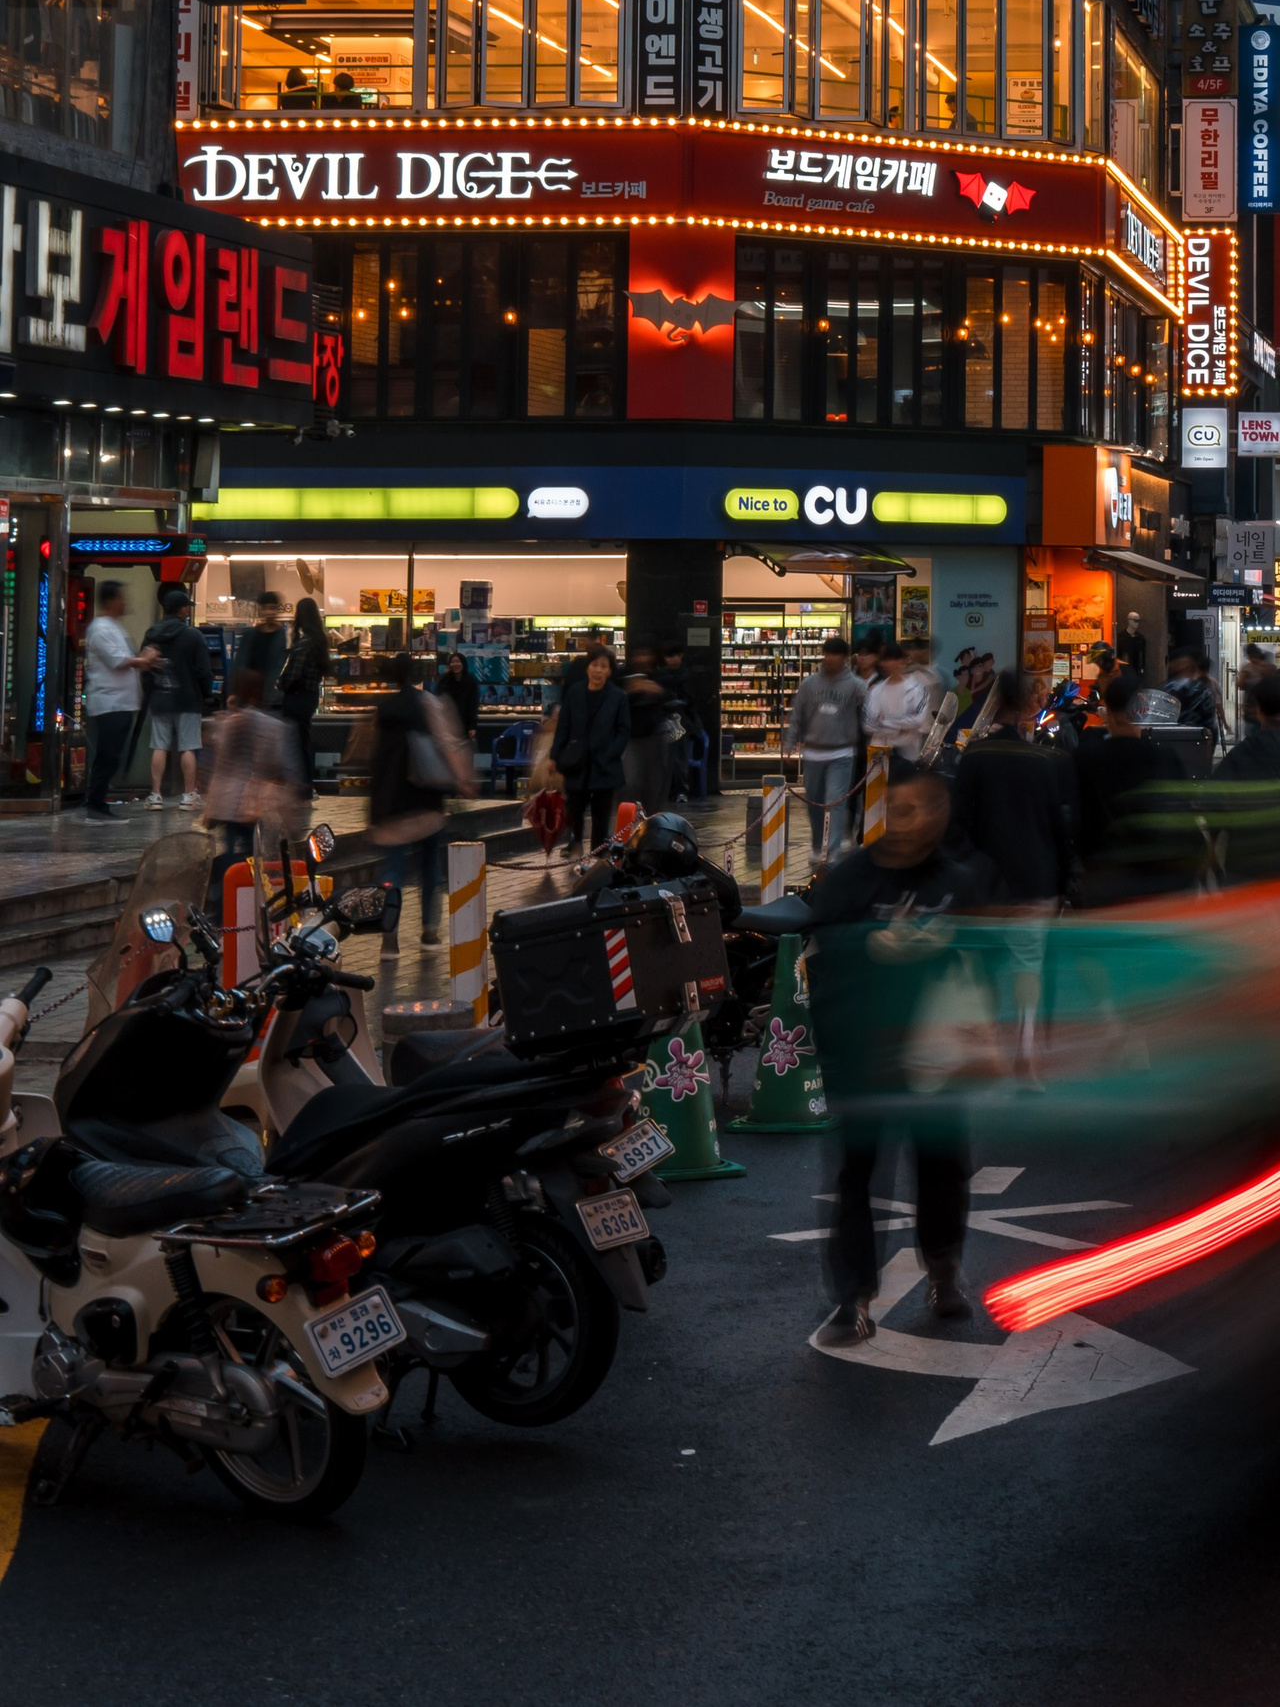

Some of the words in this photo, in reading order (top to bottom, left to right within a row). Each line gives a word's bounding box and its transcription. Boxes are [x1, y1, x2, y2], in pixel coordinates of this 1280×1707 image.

[1188, 22, 1232, 40] 소주
[1201, 41, 1218, 53] &
[1188, 56, 1232, 72] 호프
[1197, 79, 1223, 90] 4/5F
[1253, 54, 1269, 116] EDIYA
[1200, 107, 1220, 191] 무한리필
[1253, 119, 1269, 198] COFFEE
[183, 145, 379, 202] DEVIL
[396, 151, 533, 202] DICE
[763, 148, 938, 197] 보드게임카페
[580, 180, 647, 199] 보드카페
[763, 191, 804, 207] Board
[806, 196, 844, 212] game
[846, 199, 876, 214] cafe
[1204, 206, 1214, 214] 3F
[1187, 238, 1210, 315] DEVIL
[92, 219, 314, 390] 게임랜드
[1213, 305, 1227, 355] 보드게임
[1187, 324, 1210, 385] DICE
[1213, 359, 1227, 386] 카페
[1193, 430, 1214, 441] CU
[1241, 419, 1272, 431] LENS
[1241, 432, 1279, 442] TOWN
[738, 495, 770, 512] Nice
[773, 497, 788, 512] to
[803, 484, 868, 526] CU
[1235, 531, 1266, 551] 네일
[1233, 549, 1267, 565] 아트
[968, 615, 981, 624] CU
[623, 1134, 663, 1168] 6937
[601, 1210, 639, 1237] 6364
[329, 1317, 346, 1332] 부산
[340, 1313, 392, 1355] 9296
